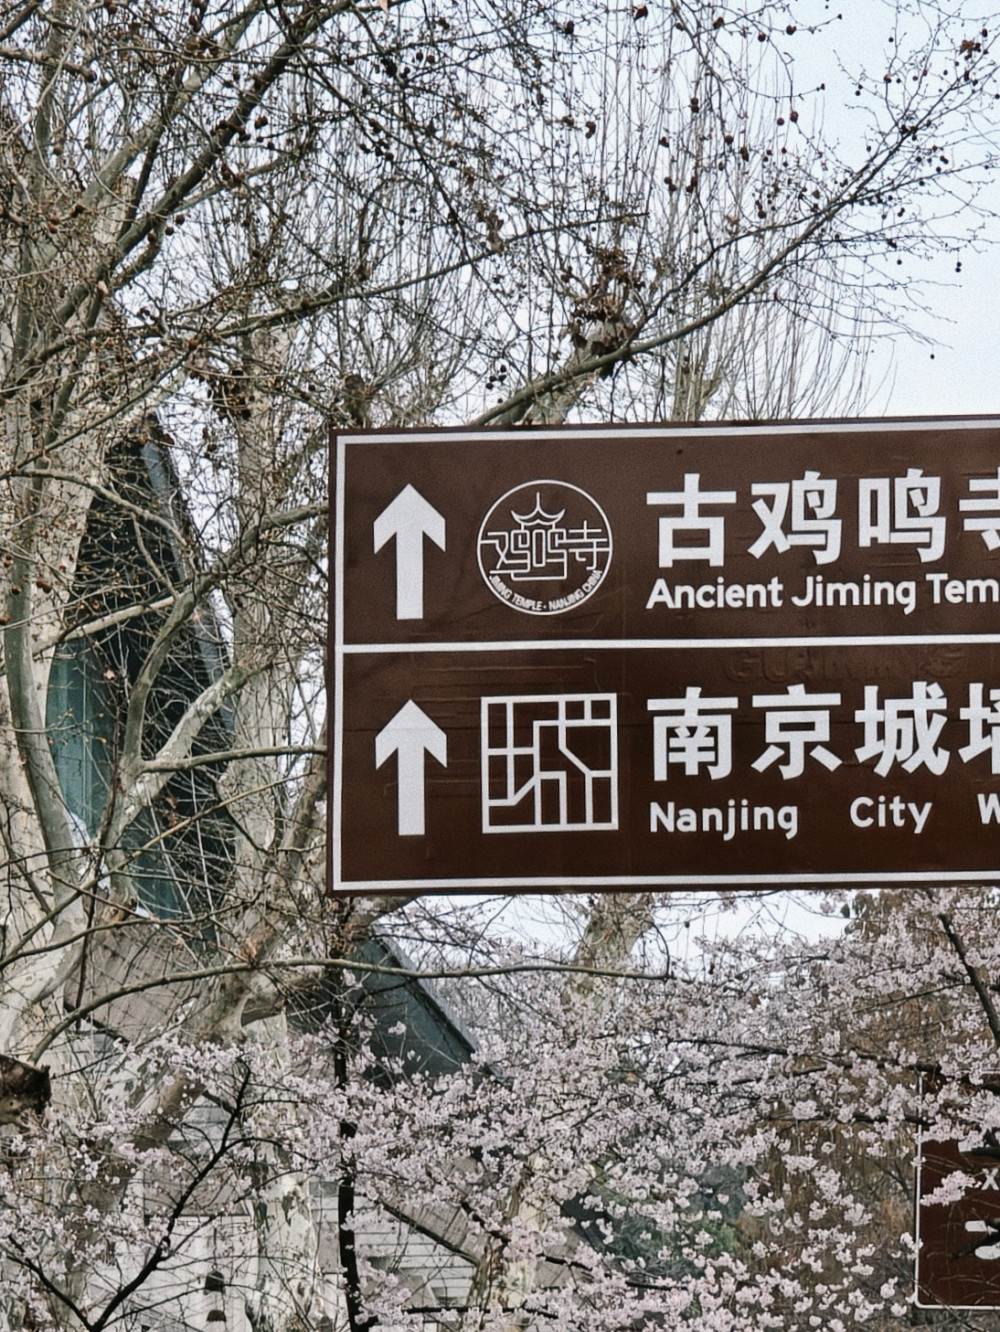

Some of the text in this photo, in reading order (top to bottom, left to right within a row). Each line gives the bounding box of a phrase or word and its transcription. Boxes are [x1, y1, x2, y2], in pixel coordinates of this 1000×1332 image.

[512, 592, 543, 611] TEMPLE
[548, 588, 585, 611] NANJING
[646, 576, 783, 609] Ancient
[791, 574, 916, 615] Jiming
[650, 799, 798, 841] Nanjing
[850, 795, 933, 834] City
